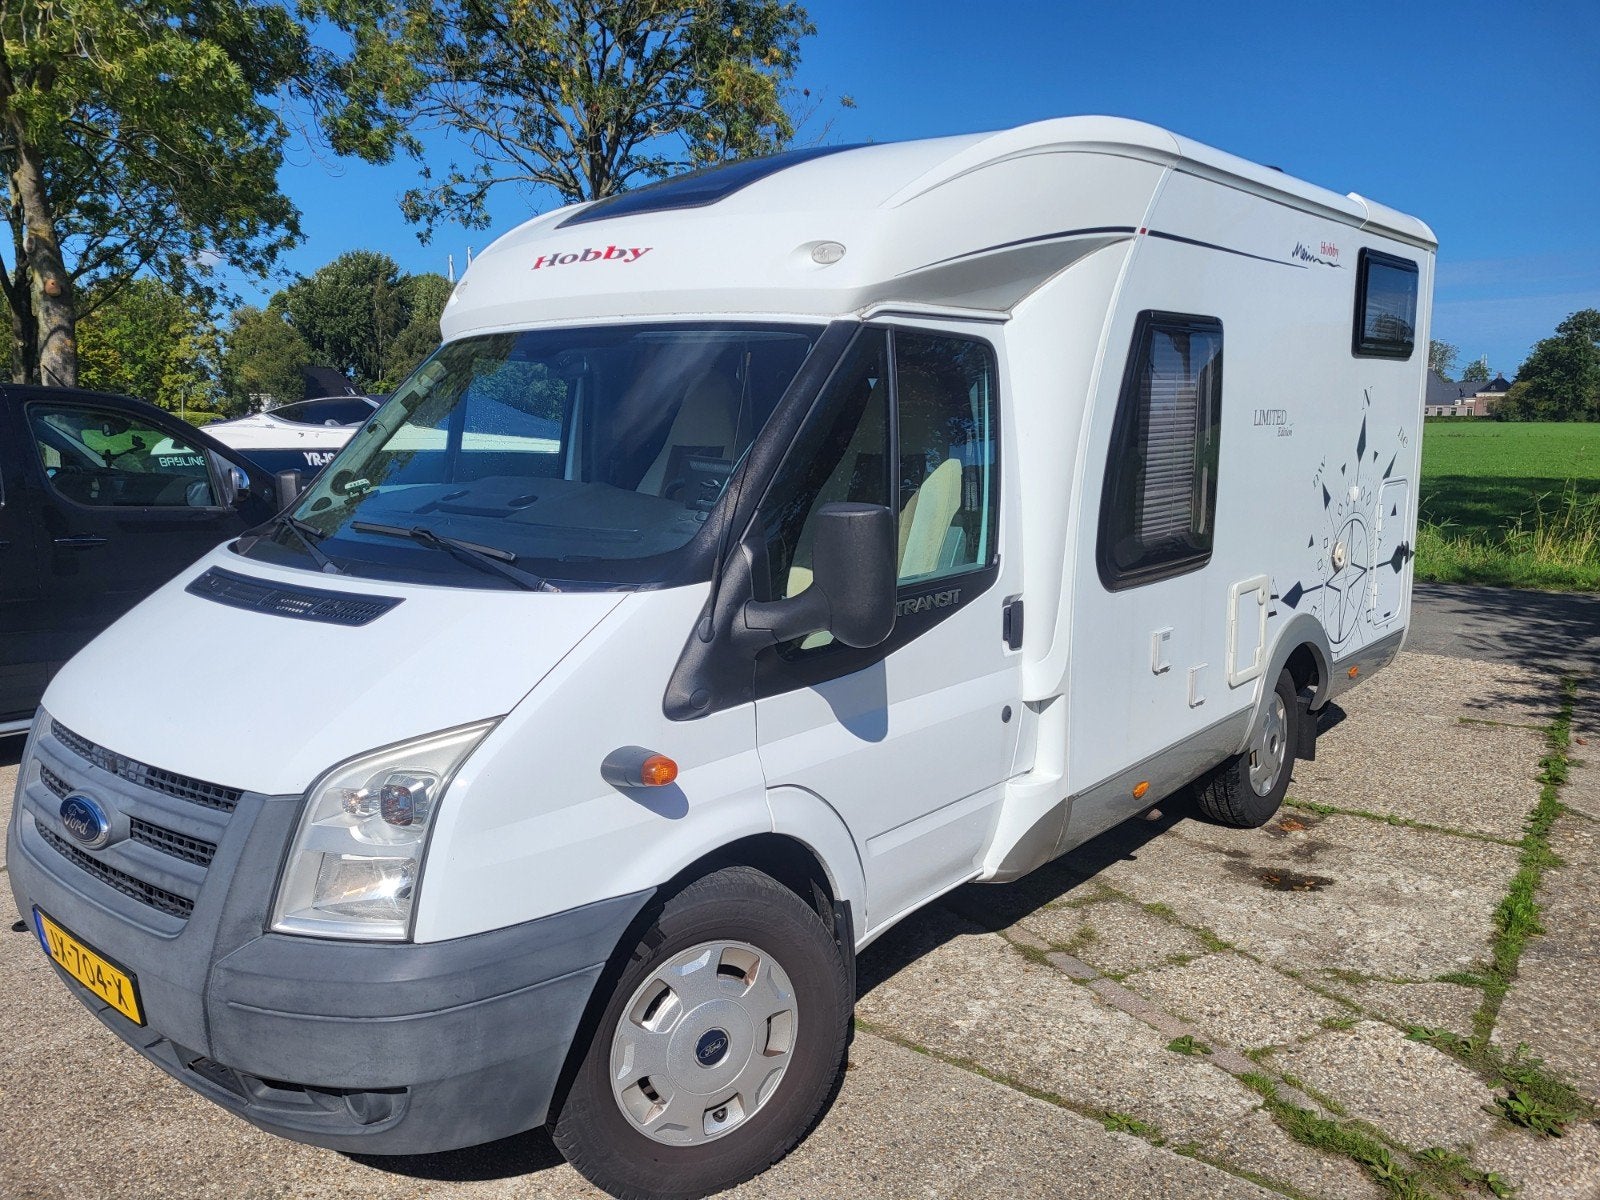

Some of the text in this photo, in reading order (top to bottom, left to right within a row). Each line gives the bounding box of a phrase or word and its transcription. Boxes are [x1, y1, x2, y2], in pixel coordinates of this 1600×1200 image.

[531, 245, 654, 271] Hobby
[1319, 240, 1340, 262] Hobby
[1361, 385, 1374, 410] N
[1253, 409, 1288, 426] LIMITED
[1277, 426, 1293, 437] Edition
[896, 588, 962, 617] TRANSIT
[63, 803, 90, 835] Ford
[50, 928, 131, 1012] JX-704-X
[704, 1040, 722, 1057] Ford
